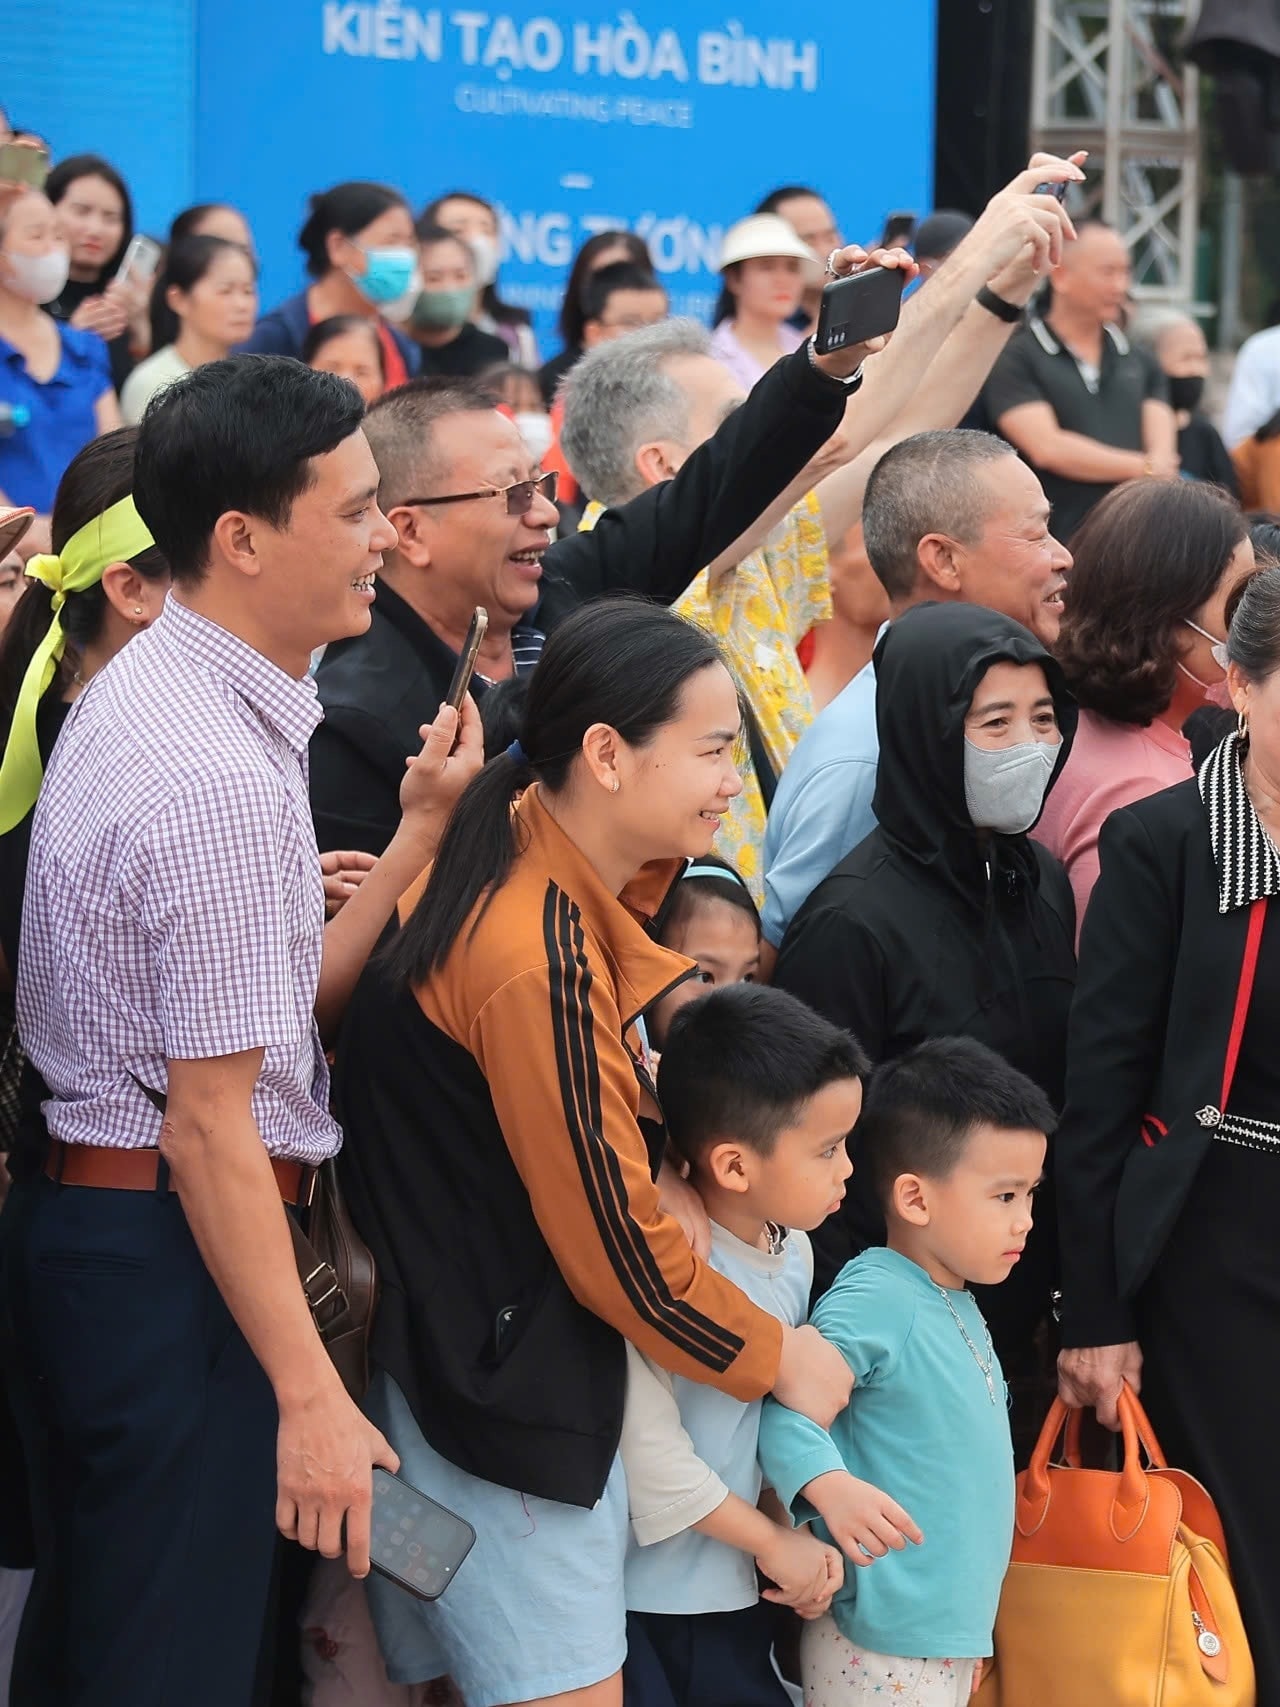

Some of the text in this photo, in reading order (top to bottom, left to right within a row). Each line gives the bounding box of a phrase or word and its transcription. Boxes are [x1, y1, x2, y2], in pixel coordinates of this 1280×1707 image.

[451, 10, 564, 81] TẠO
[573, 9, 688, 82] HÒA
[698, 18, 817, 91] BÌNH
[455, 84, 694, 129] CULTIVATING PEACE
[496, 203, 572, 267] NG
